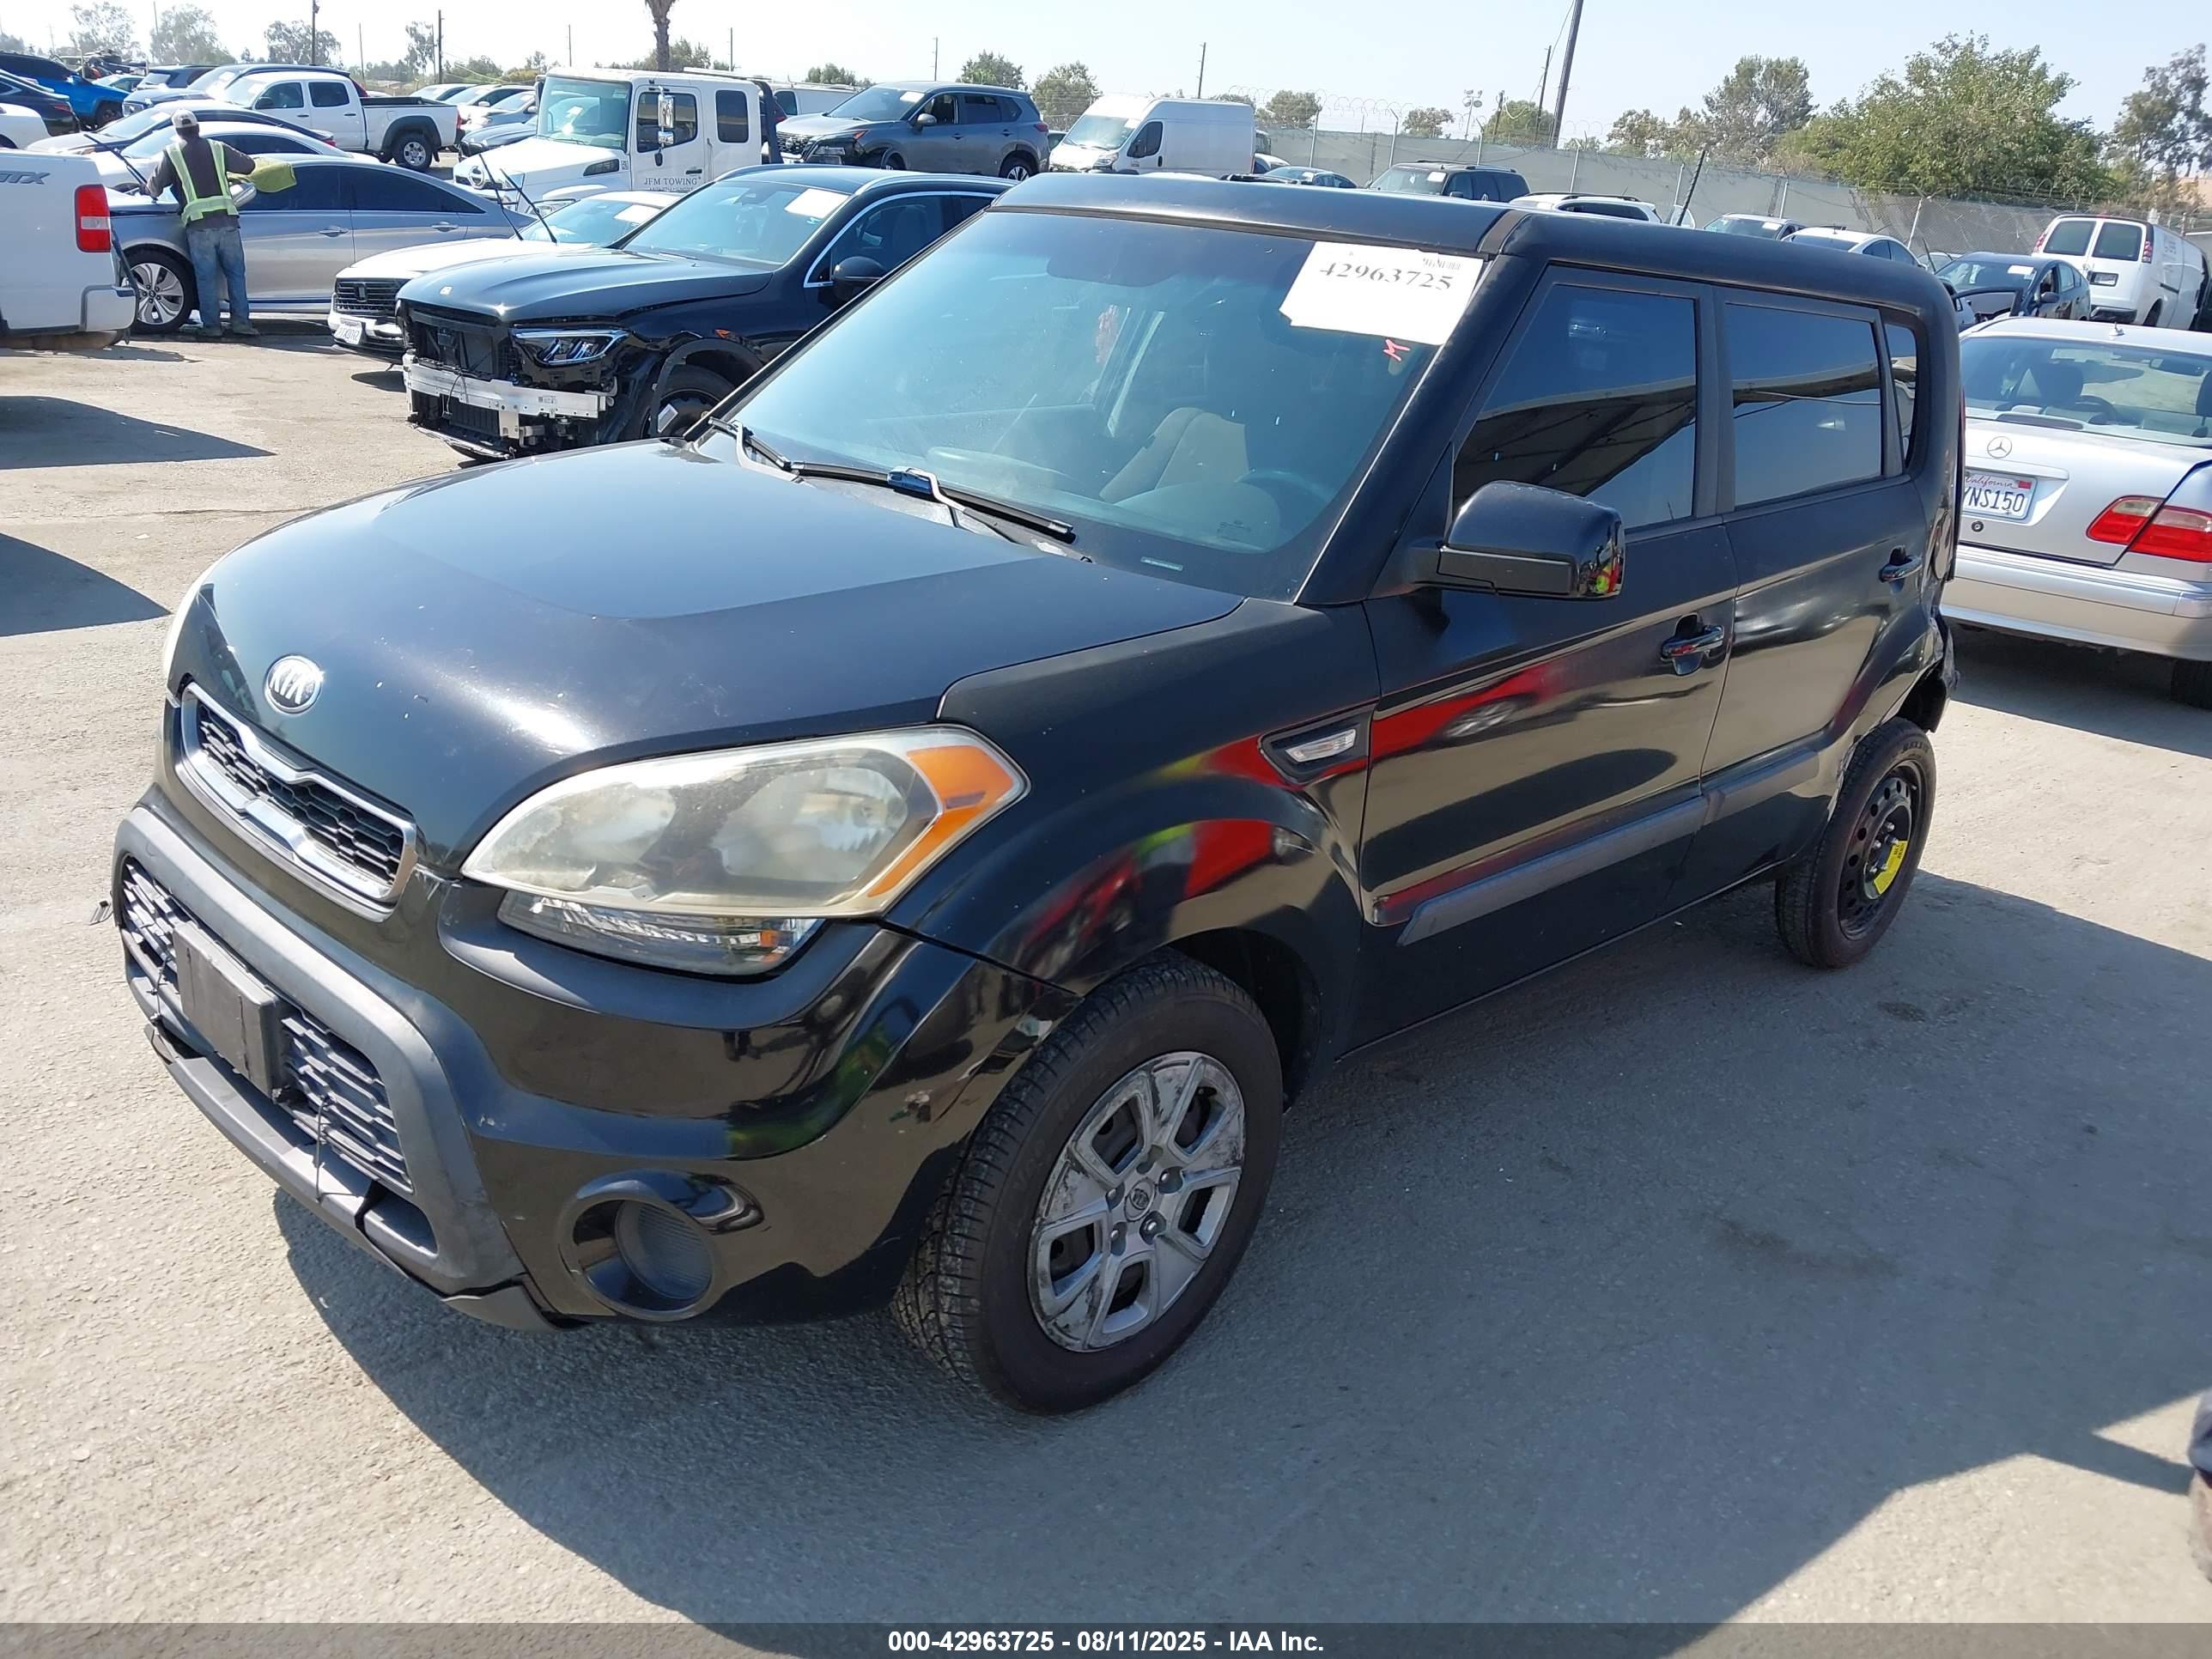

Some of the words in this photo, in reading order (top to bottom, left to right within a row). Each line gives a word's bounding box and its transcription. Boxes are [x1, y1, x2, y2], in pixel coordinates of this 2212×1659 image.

[644, 177, 661, 185] JFM
[664, 177, 697, 185] TOWING
[1320, 262, 1454, 290] 42963725
